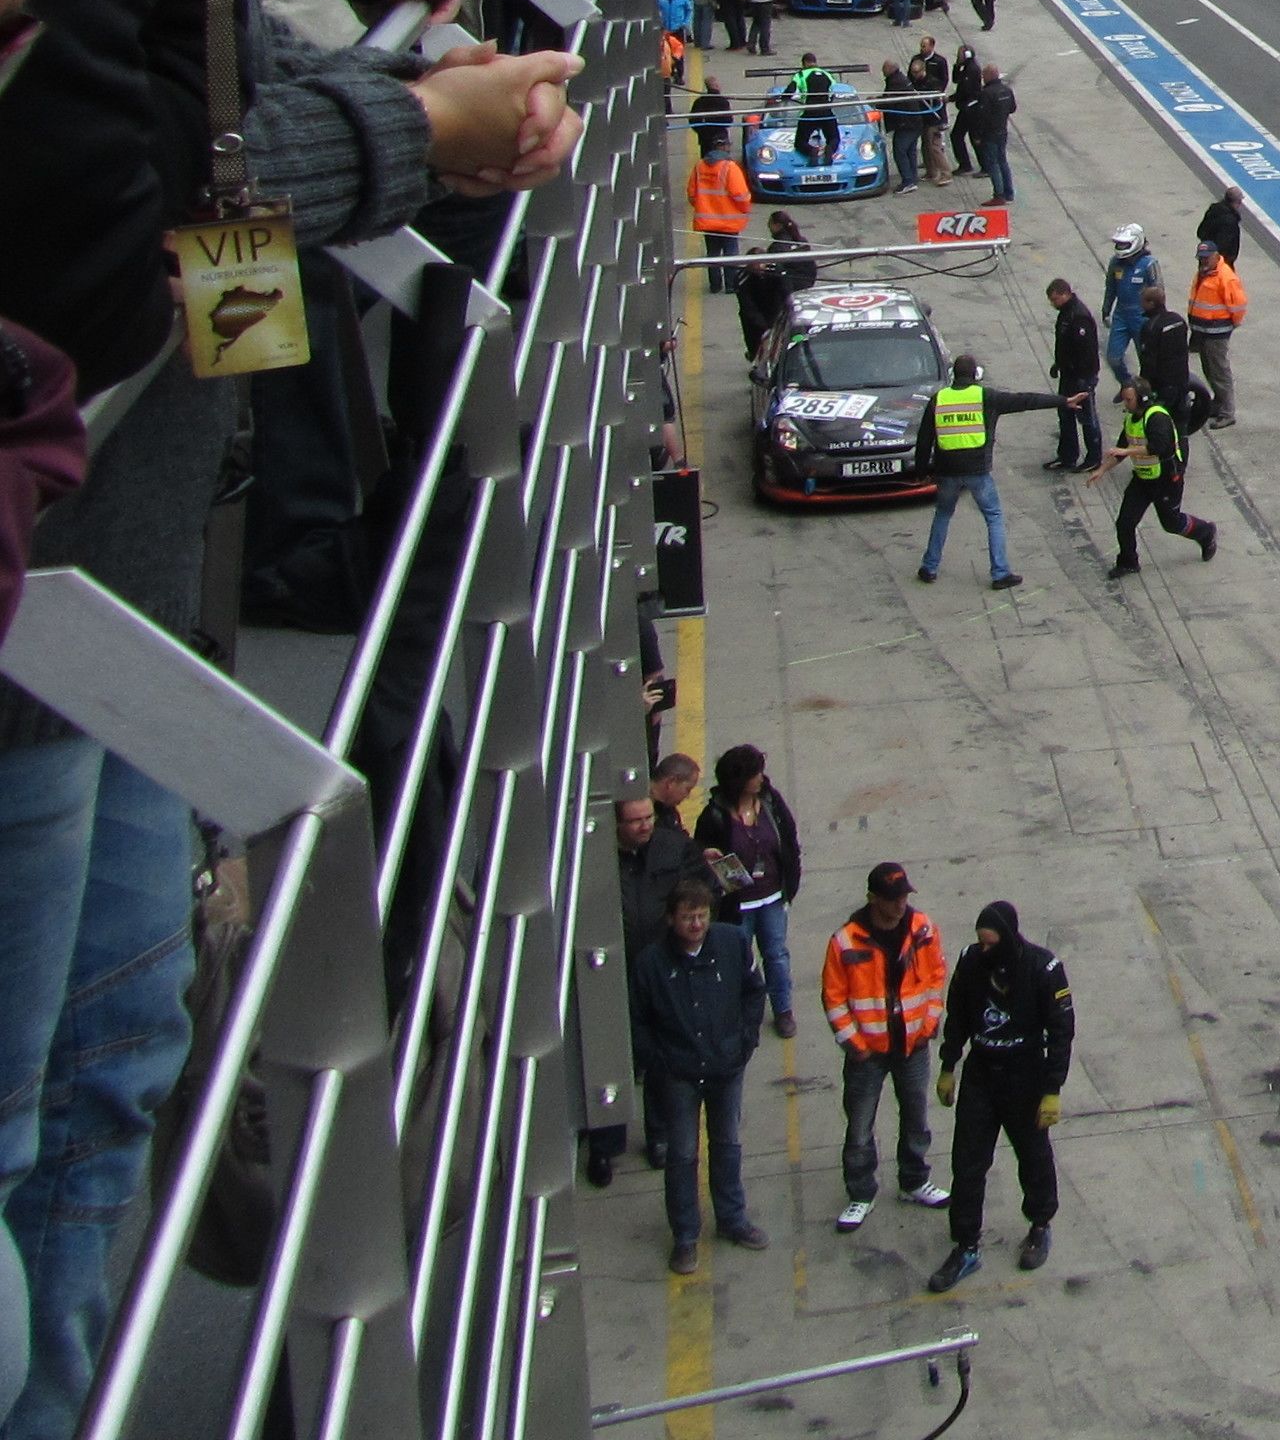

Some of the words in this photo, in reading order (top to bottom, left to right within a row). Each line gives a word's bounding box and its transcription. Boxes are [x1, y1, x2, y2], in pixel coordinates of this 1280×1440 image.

[936, 213, 988, 237] RTR
[196, 228, 272, 267] VIP
[785, 398, 838, 415] 285
[943, 413, 955, 423] PIT
[957, 412, 977, 422] WALL
[655, 522, 687, 545] TR
